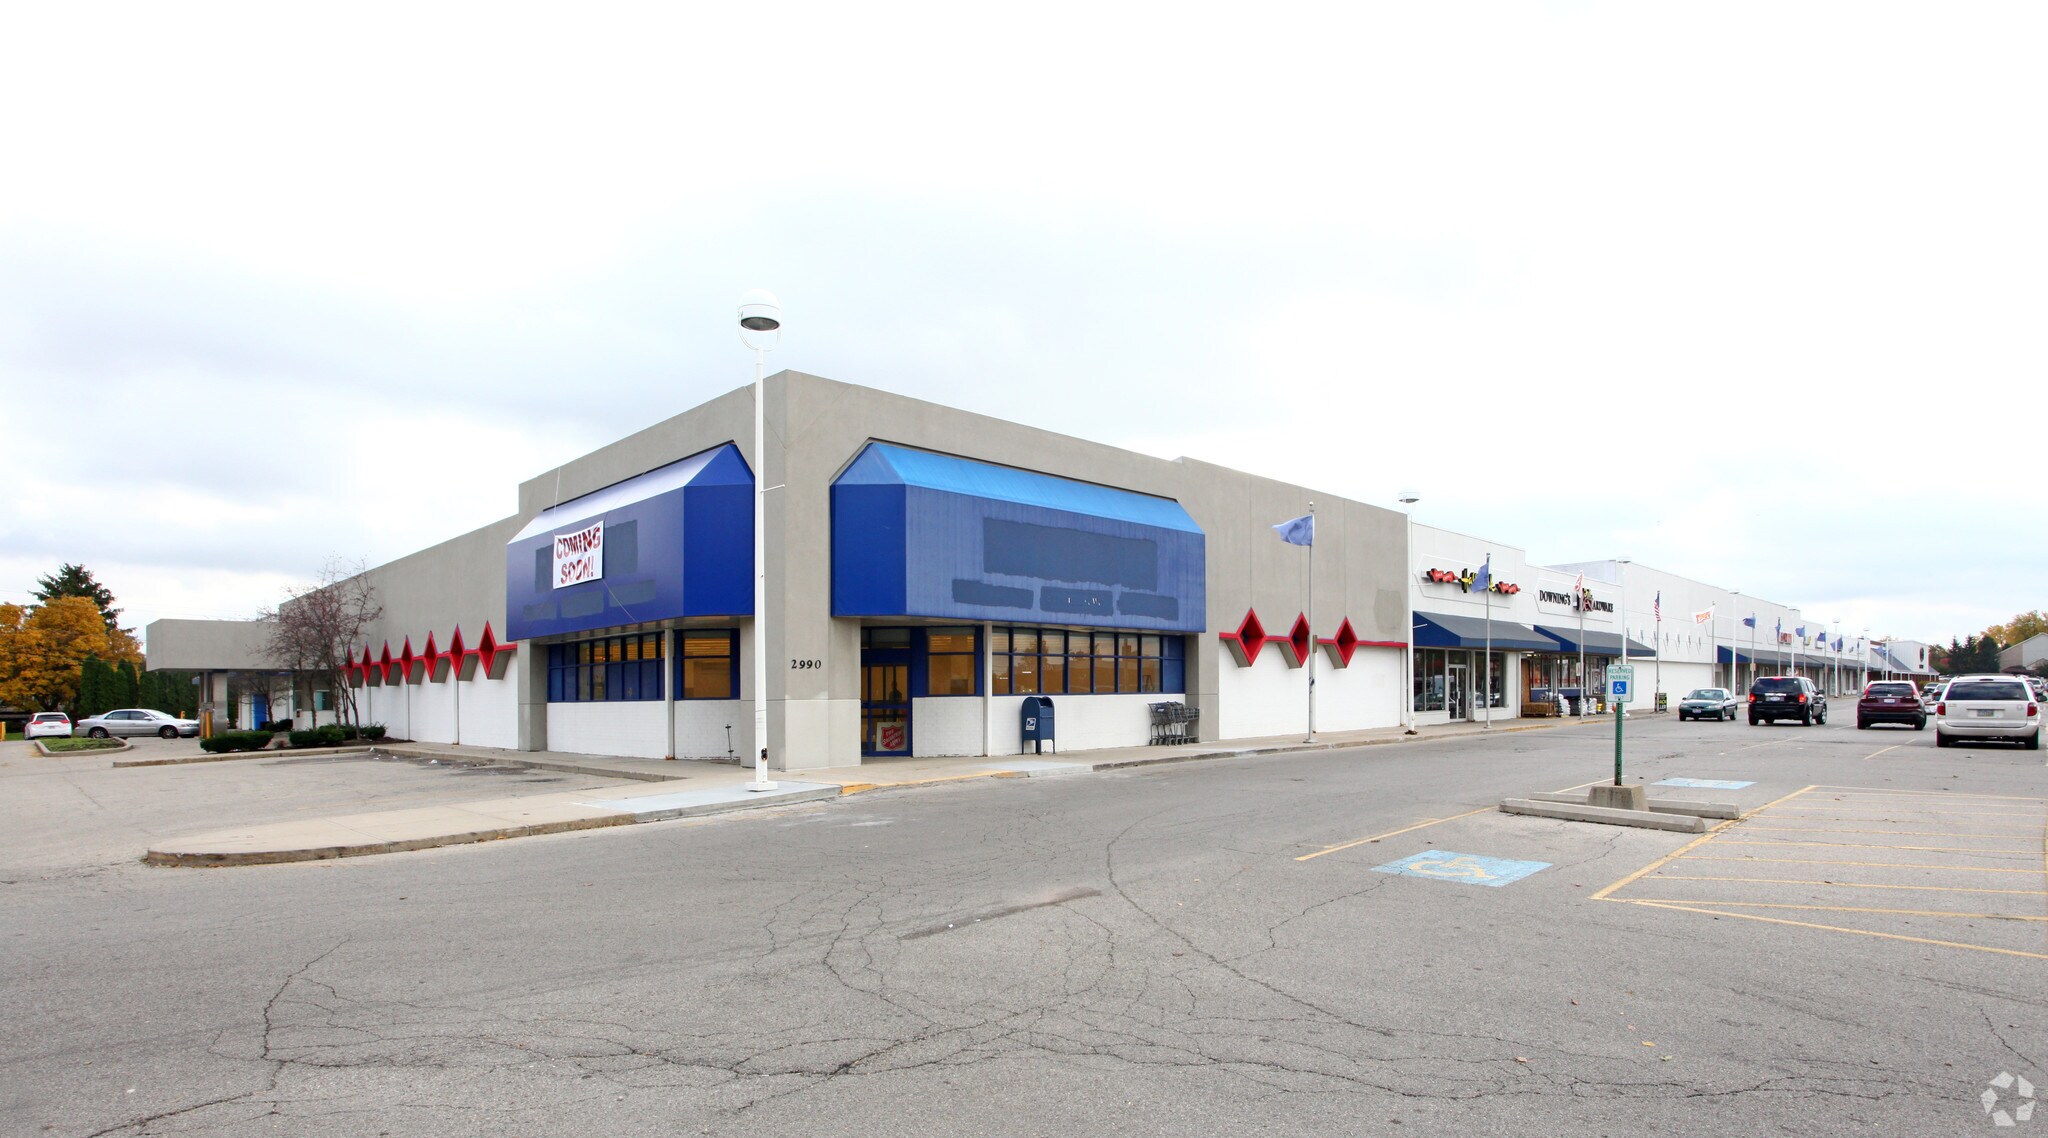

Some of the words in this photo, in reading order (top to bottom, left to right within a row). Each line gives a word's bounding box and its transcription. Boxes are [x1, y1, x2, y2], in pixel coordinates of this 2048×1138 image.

[556, 527, 601, 559] COMING
[561, 555, 595, 584] SOON!
[1539, 589, 1571, 606] DOWNING'S
[791, 659, 822, 670] 2990
